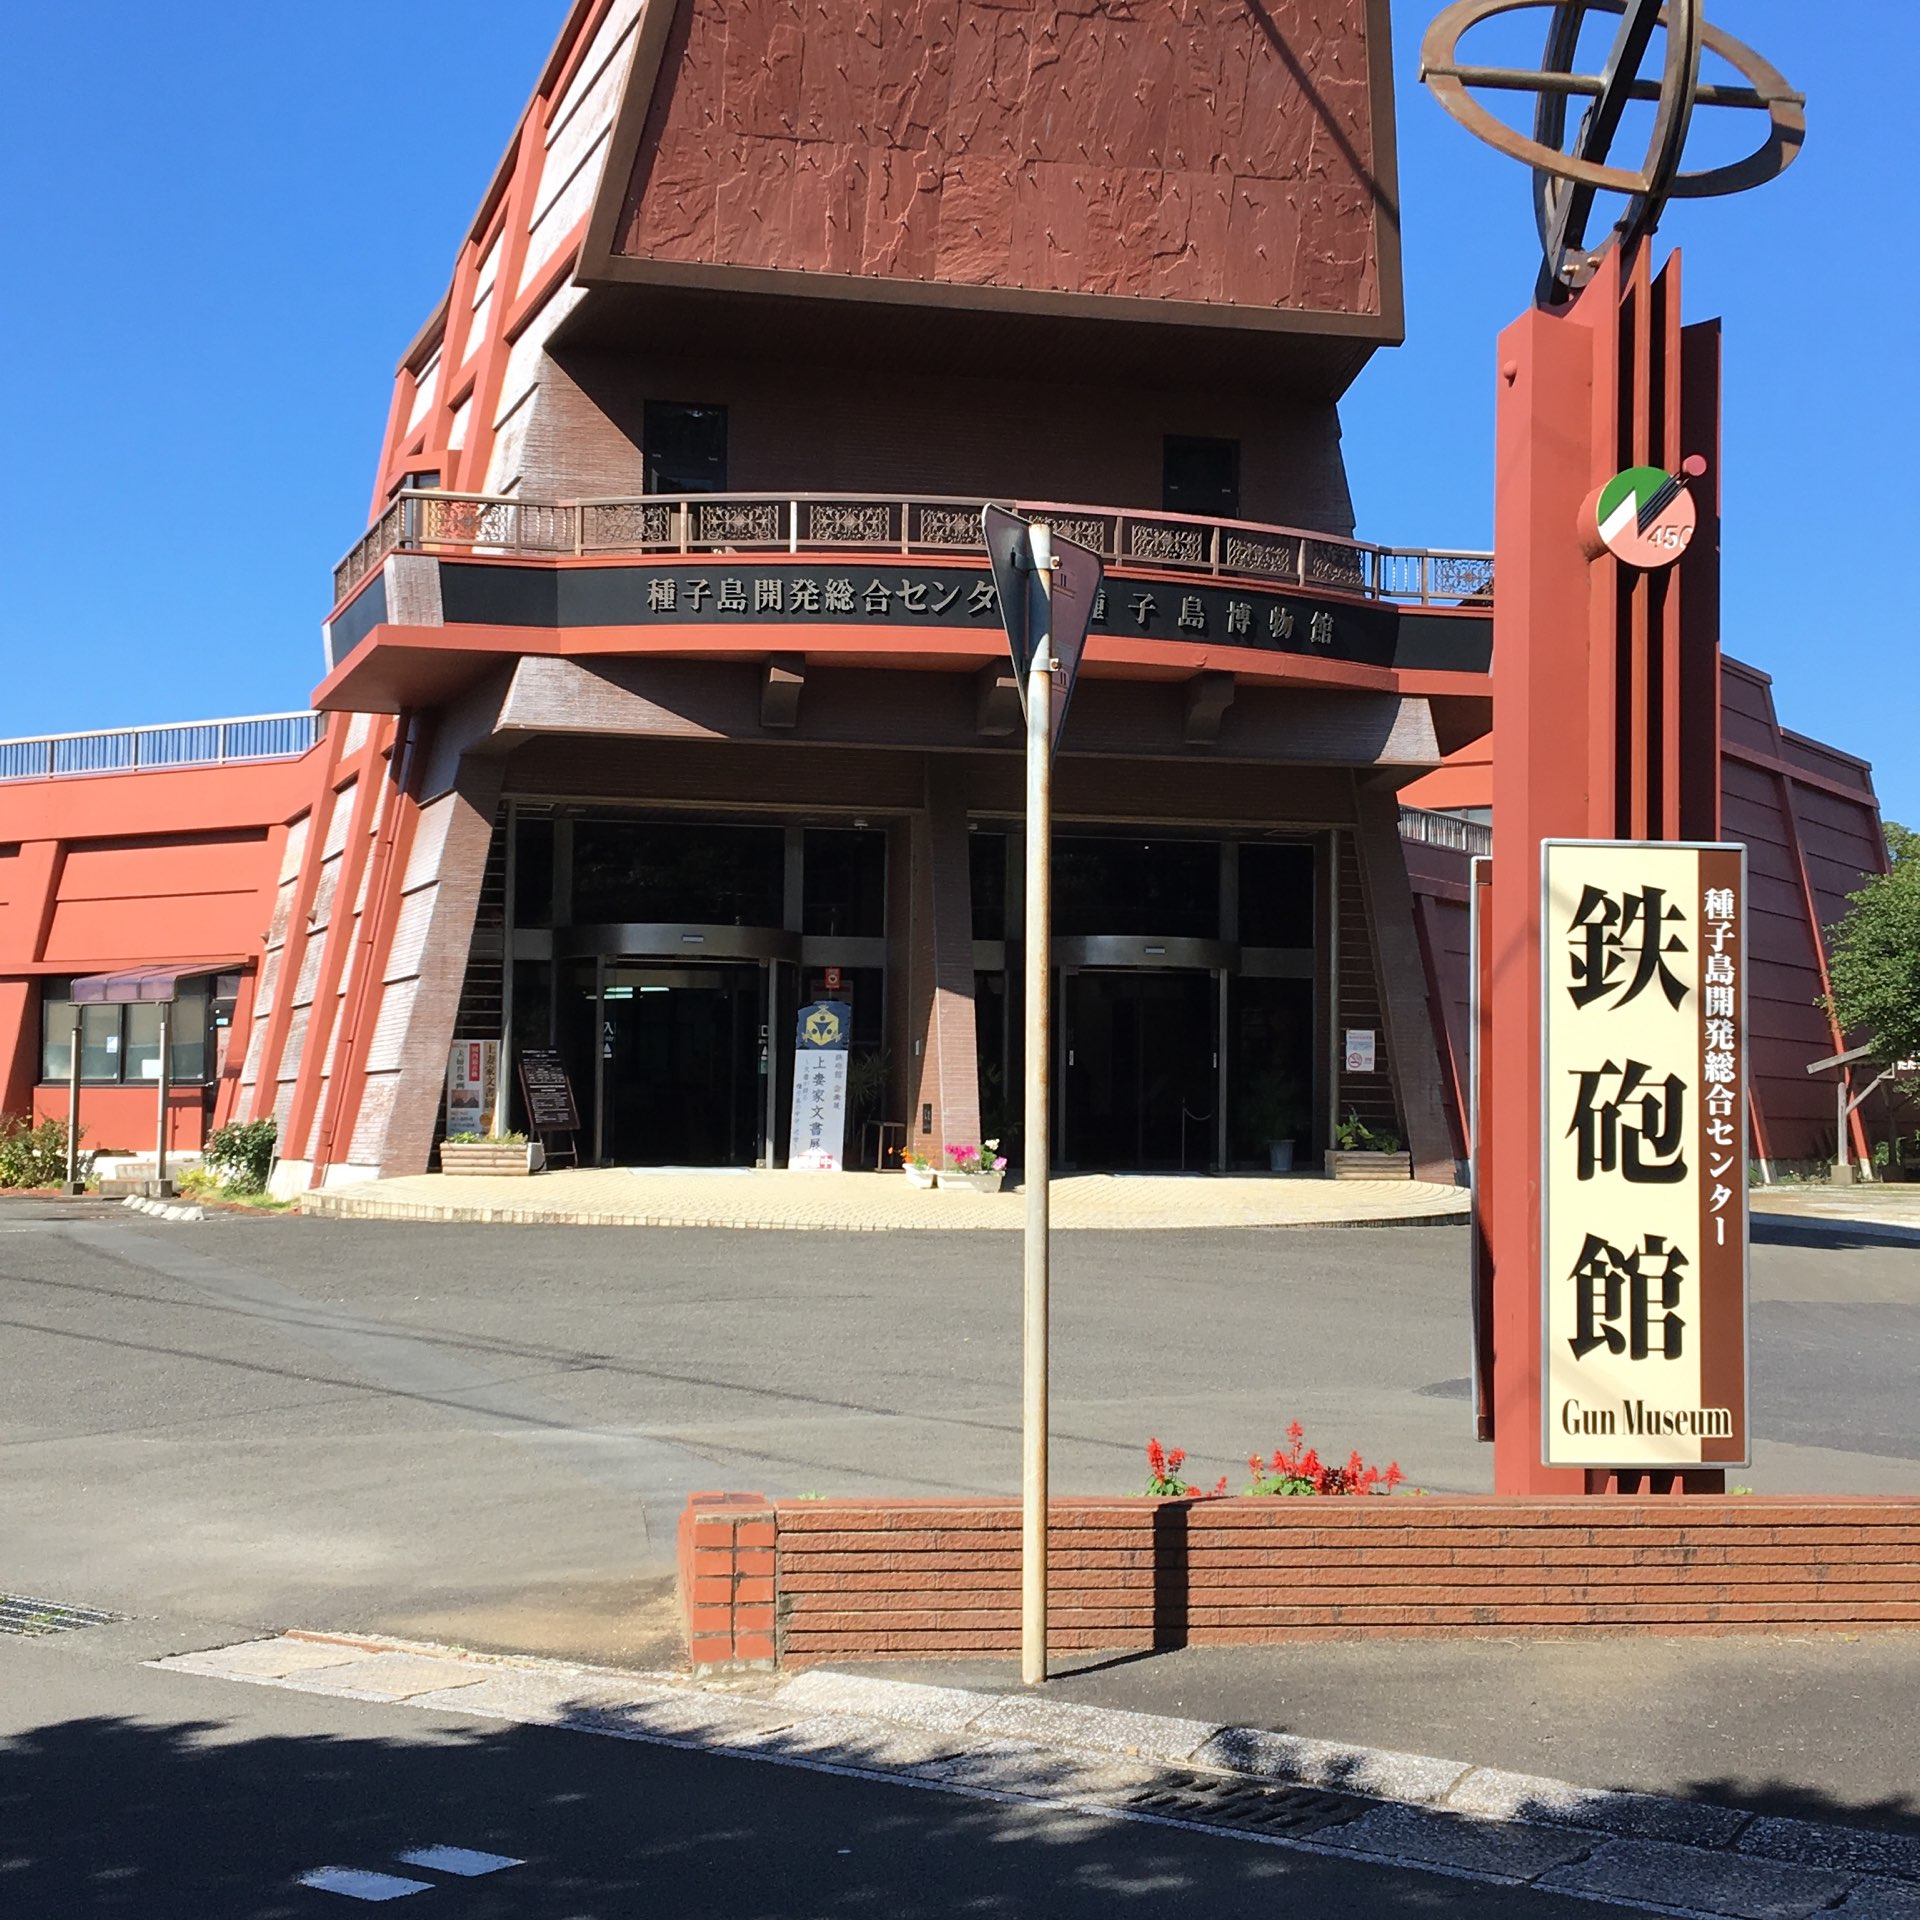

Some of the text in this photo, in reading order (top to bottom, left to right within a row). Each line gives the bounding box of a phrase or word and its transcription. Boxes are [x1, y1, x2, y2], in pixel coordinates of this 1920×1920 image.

[1647, 525, 1693, 549] 450
[1565, 884, 1691, 1362] 鉄砲館
[1704, 887, 1736, 1247] 種子島開発総合センター
[1561, 1398, 1733, 1437] Gun Museum
